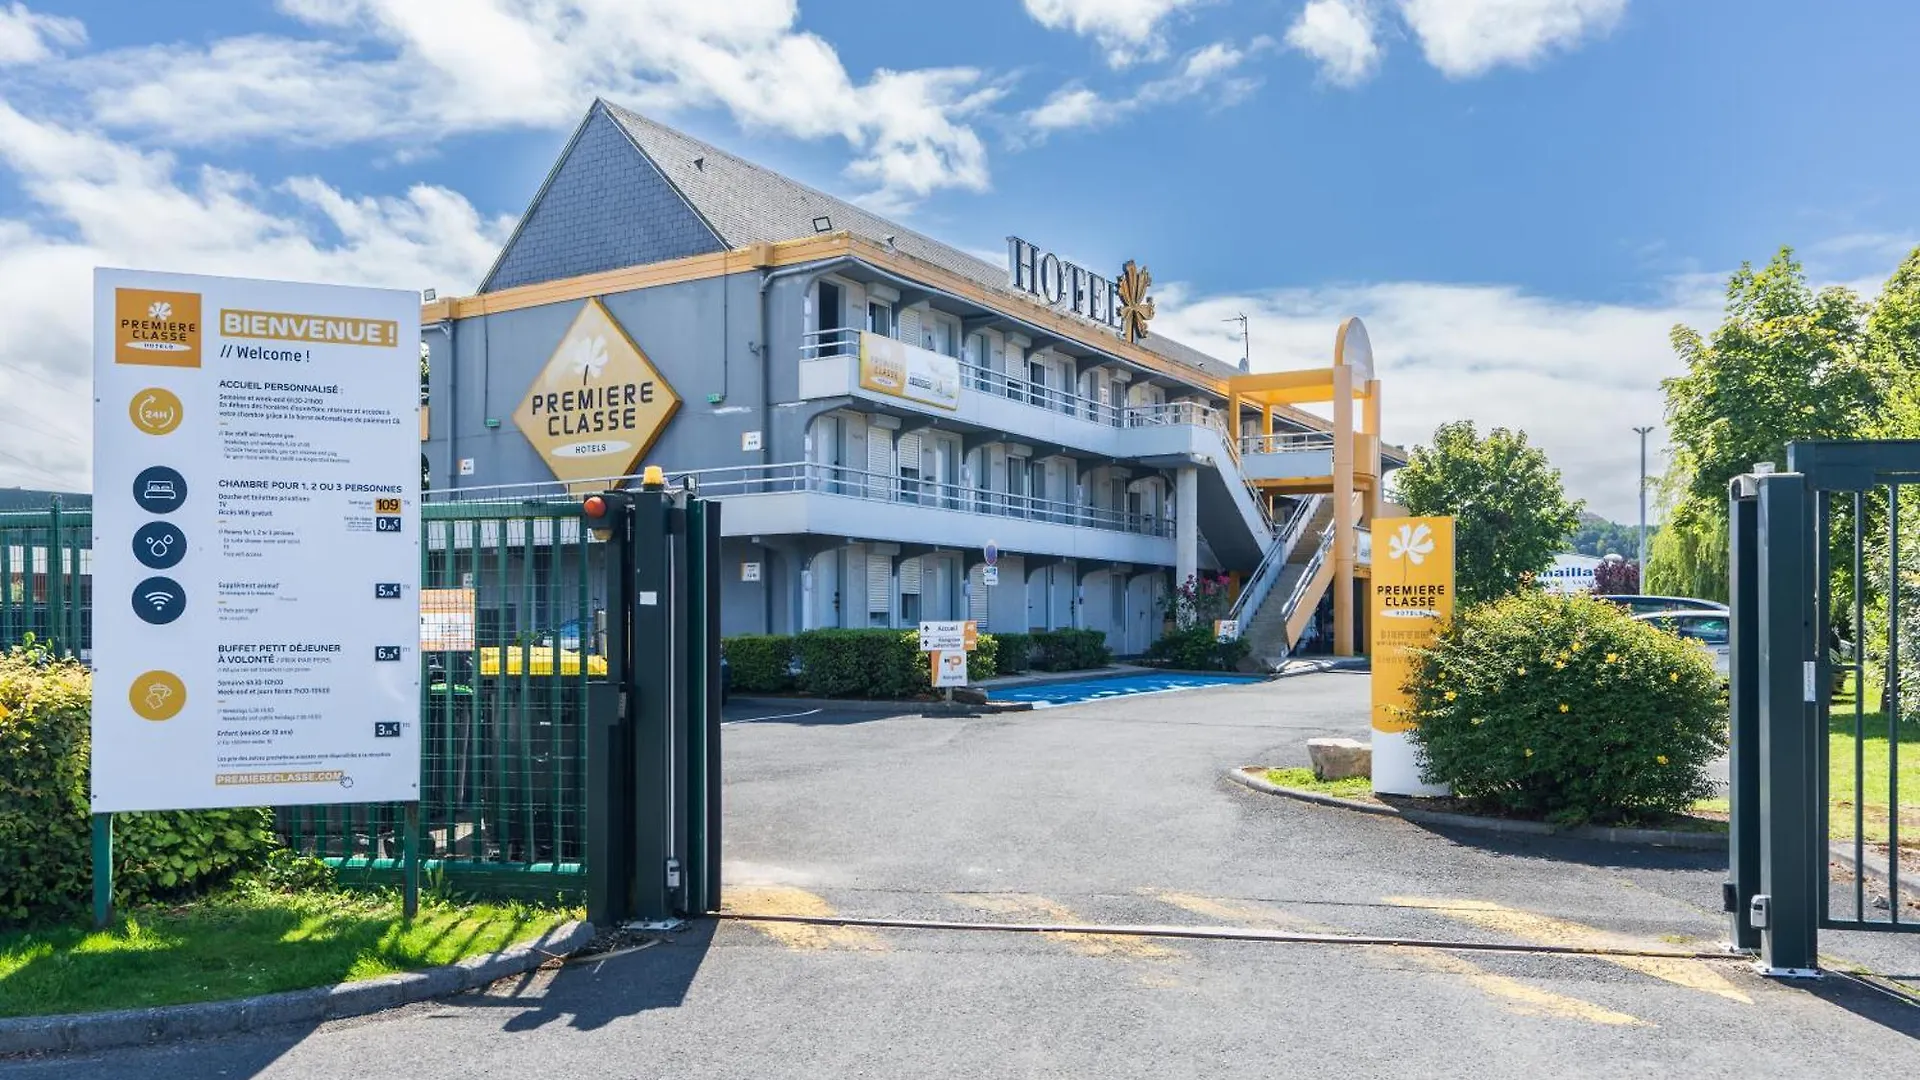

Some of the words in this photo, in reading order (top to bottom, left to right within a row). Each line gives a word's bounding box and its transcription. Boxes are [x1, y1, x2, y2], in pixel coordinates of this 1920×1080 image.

[1006, 236, 1123, 331] HOTEL
[122, 320, 195, 332] PREMIERE
[224, 313, 382, 343] BIENVENUE
[388, 325, 394, 343] !
[133, 330, 187, 341] CLASSE
[238, 345, 302, 362] Welcome
[220, 380, 262, 389] ACCUEIL
[264, 382, 338, 394] PERSONNALISÉ
[532, 381, 653, 415] PREMIERE
[548, 408, 636, 436] CLASSE
[575, 443, 606, 453] HOTELS
[218, 480, 268, 488] CHAMBRE
[345, 484, 402, 493] PERSONNES
[1377, 585, 1444, 595] PREMIERE
[1385, 597, 1435, 607] CLASSE
[289, 642, 340, 652] DÉJEUNER
[218, 654, 224, 663] À
[228, 654, 274, 663] VOLONTÉ
[217, 772, 342, 783] PREMIERECLASSE.COM
